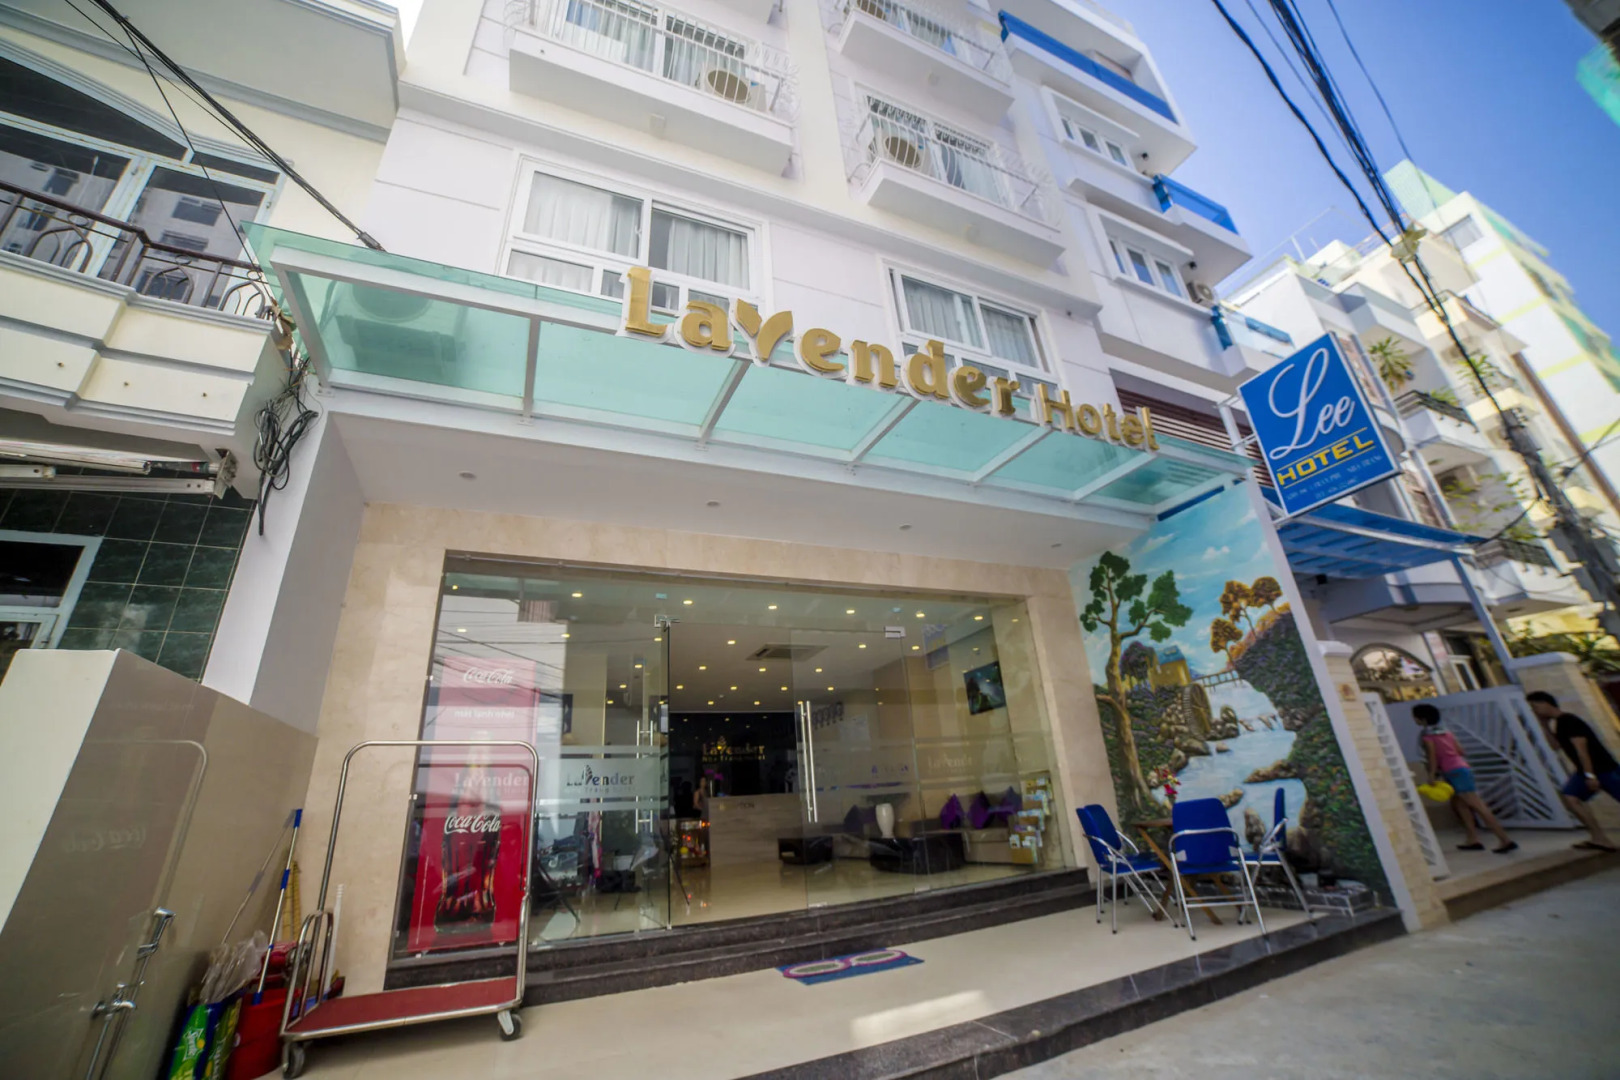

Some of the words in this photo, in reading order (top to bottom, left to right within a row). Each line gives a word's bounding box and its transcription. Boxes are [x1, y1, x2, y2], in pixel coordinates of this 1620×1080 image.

[1036, 383, 1160, 452] Hotel
[1269, 348, 1355, 460] Lee
[1276, 435, 1374, 486] HOTEL
